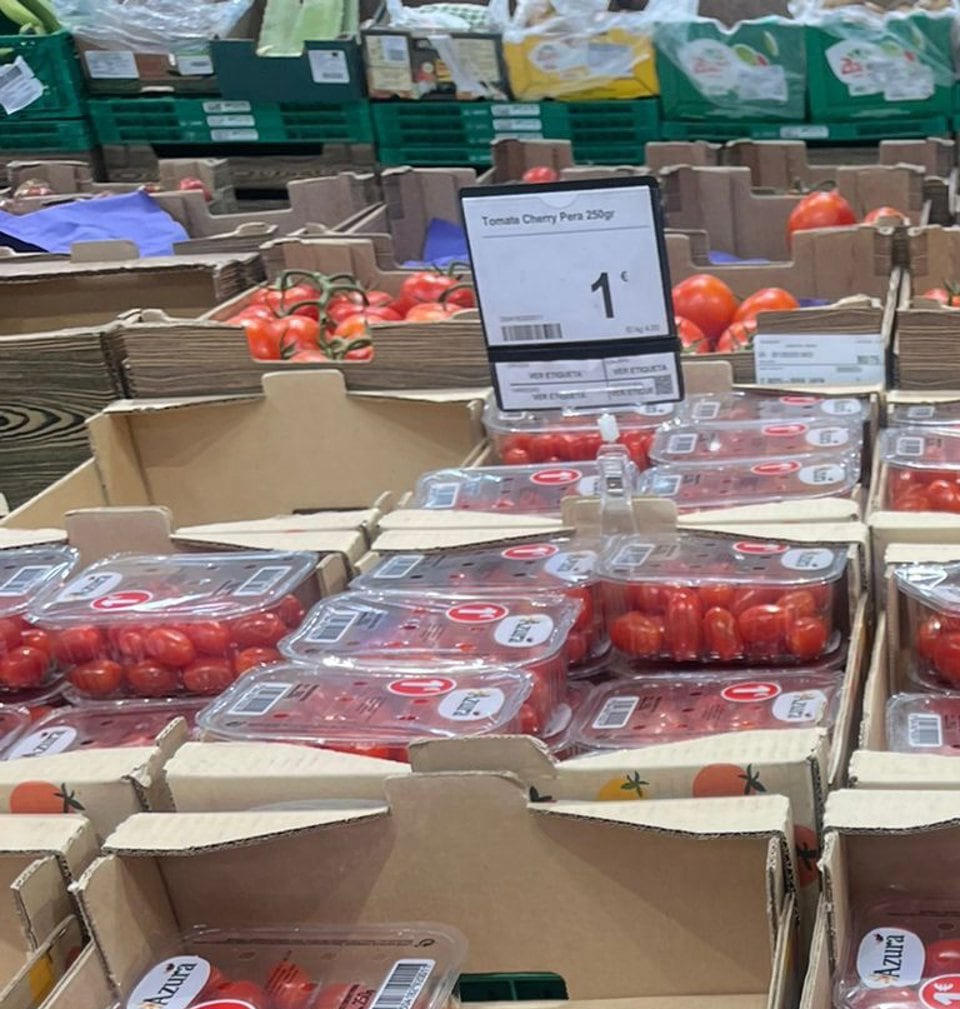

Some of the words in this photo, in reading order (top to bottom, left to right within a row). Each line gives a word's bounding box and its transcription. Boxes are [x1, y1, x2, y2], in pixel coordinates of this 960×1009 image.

[481, 215, 520, 226] Tomate
[522, 214, 557, 226] Cherry
[559, 211, 583, 221] Pera
[585, 209, 615, 220] 250gr
[874, 935, 905, 978] Azura
[142, 963, 198, 1005] Azura
